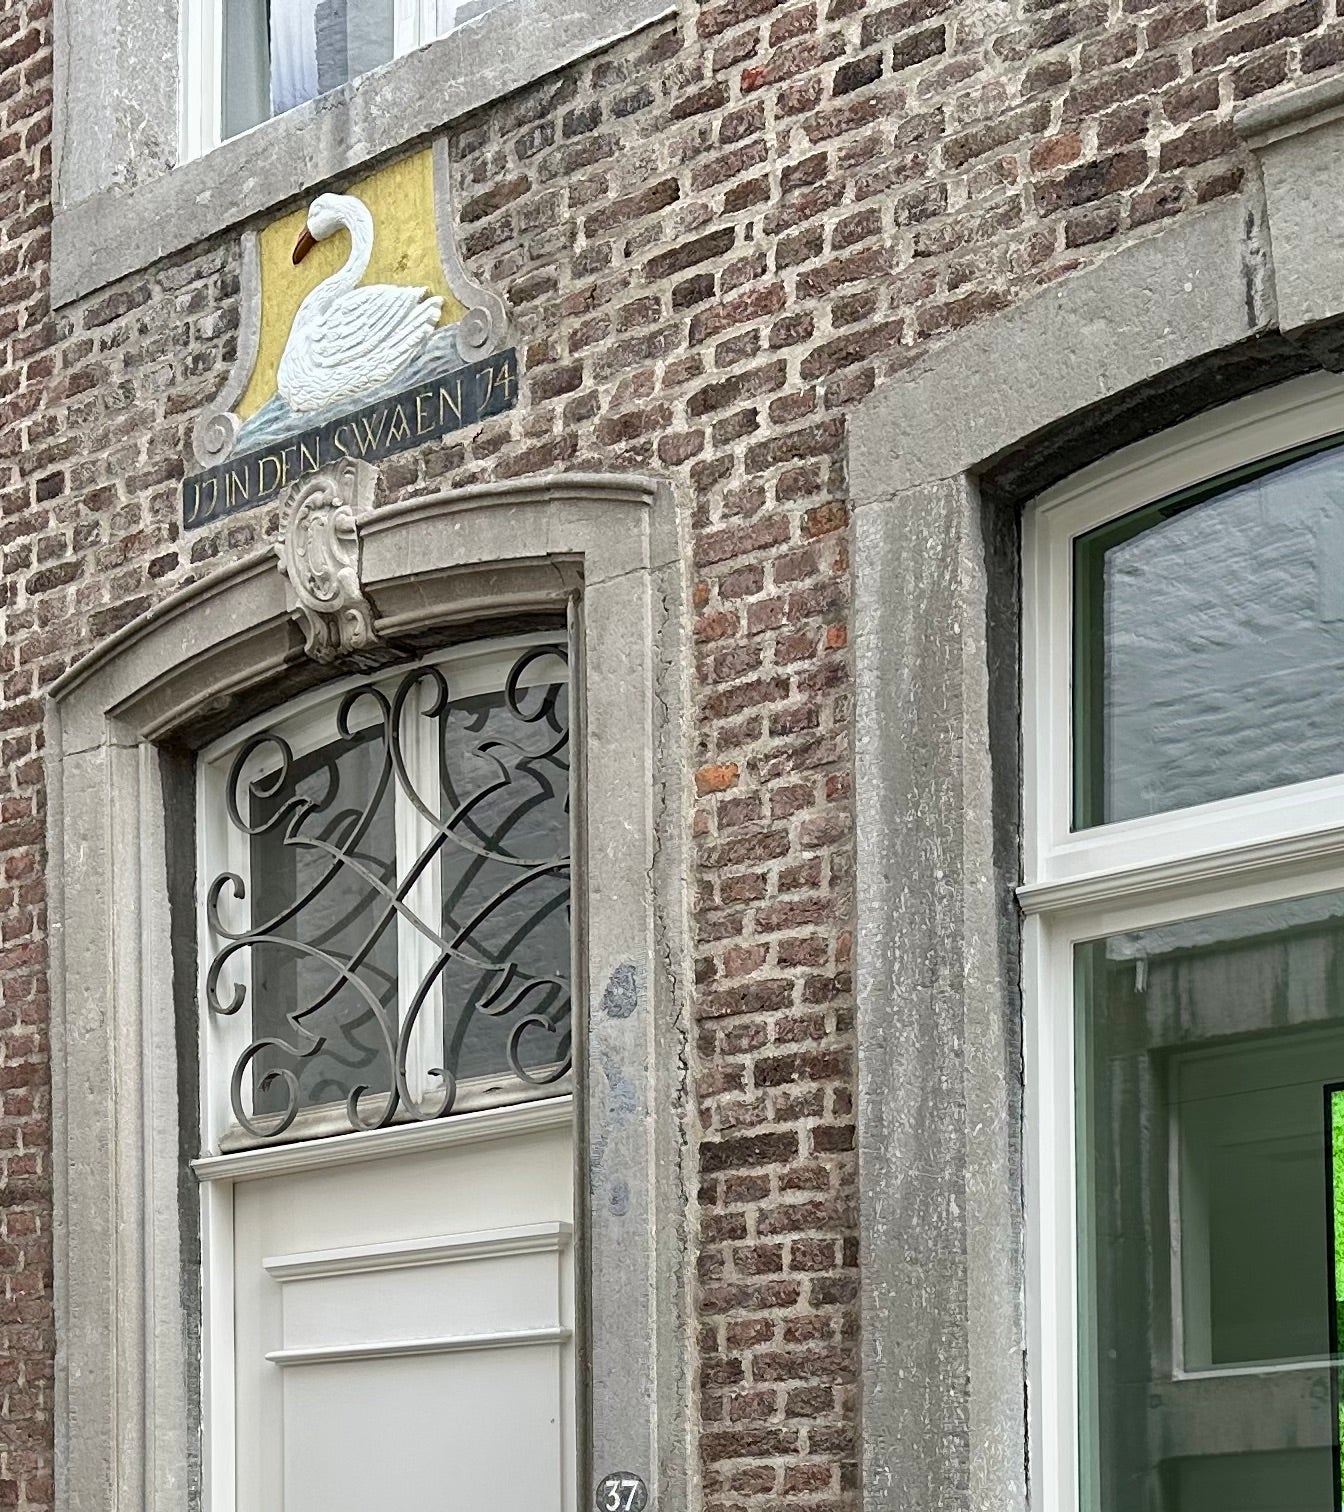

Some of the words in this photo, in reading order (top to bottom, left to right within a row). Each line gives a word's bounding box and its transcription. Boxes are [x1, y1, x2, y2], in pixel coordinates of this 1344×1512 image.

[225, 465, 249, 508] IN
[258, 436, 320, 497] DEN
[334, 379, 463, 457] SWAEN
[605, 1480, 640, 1512] 37
